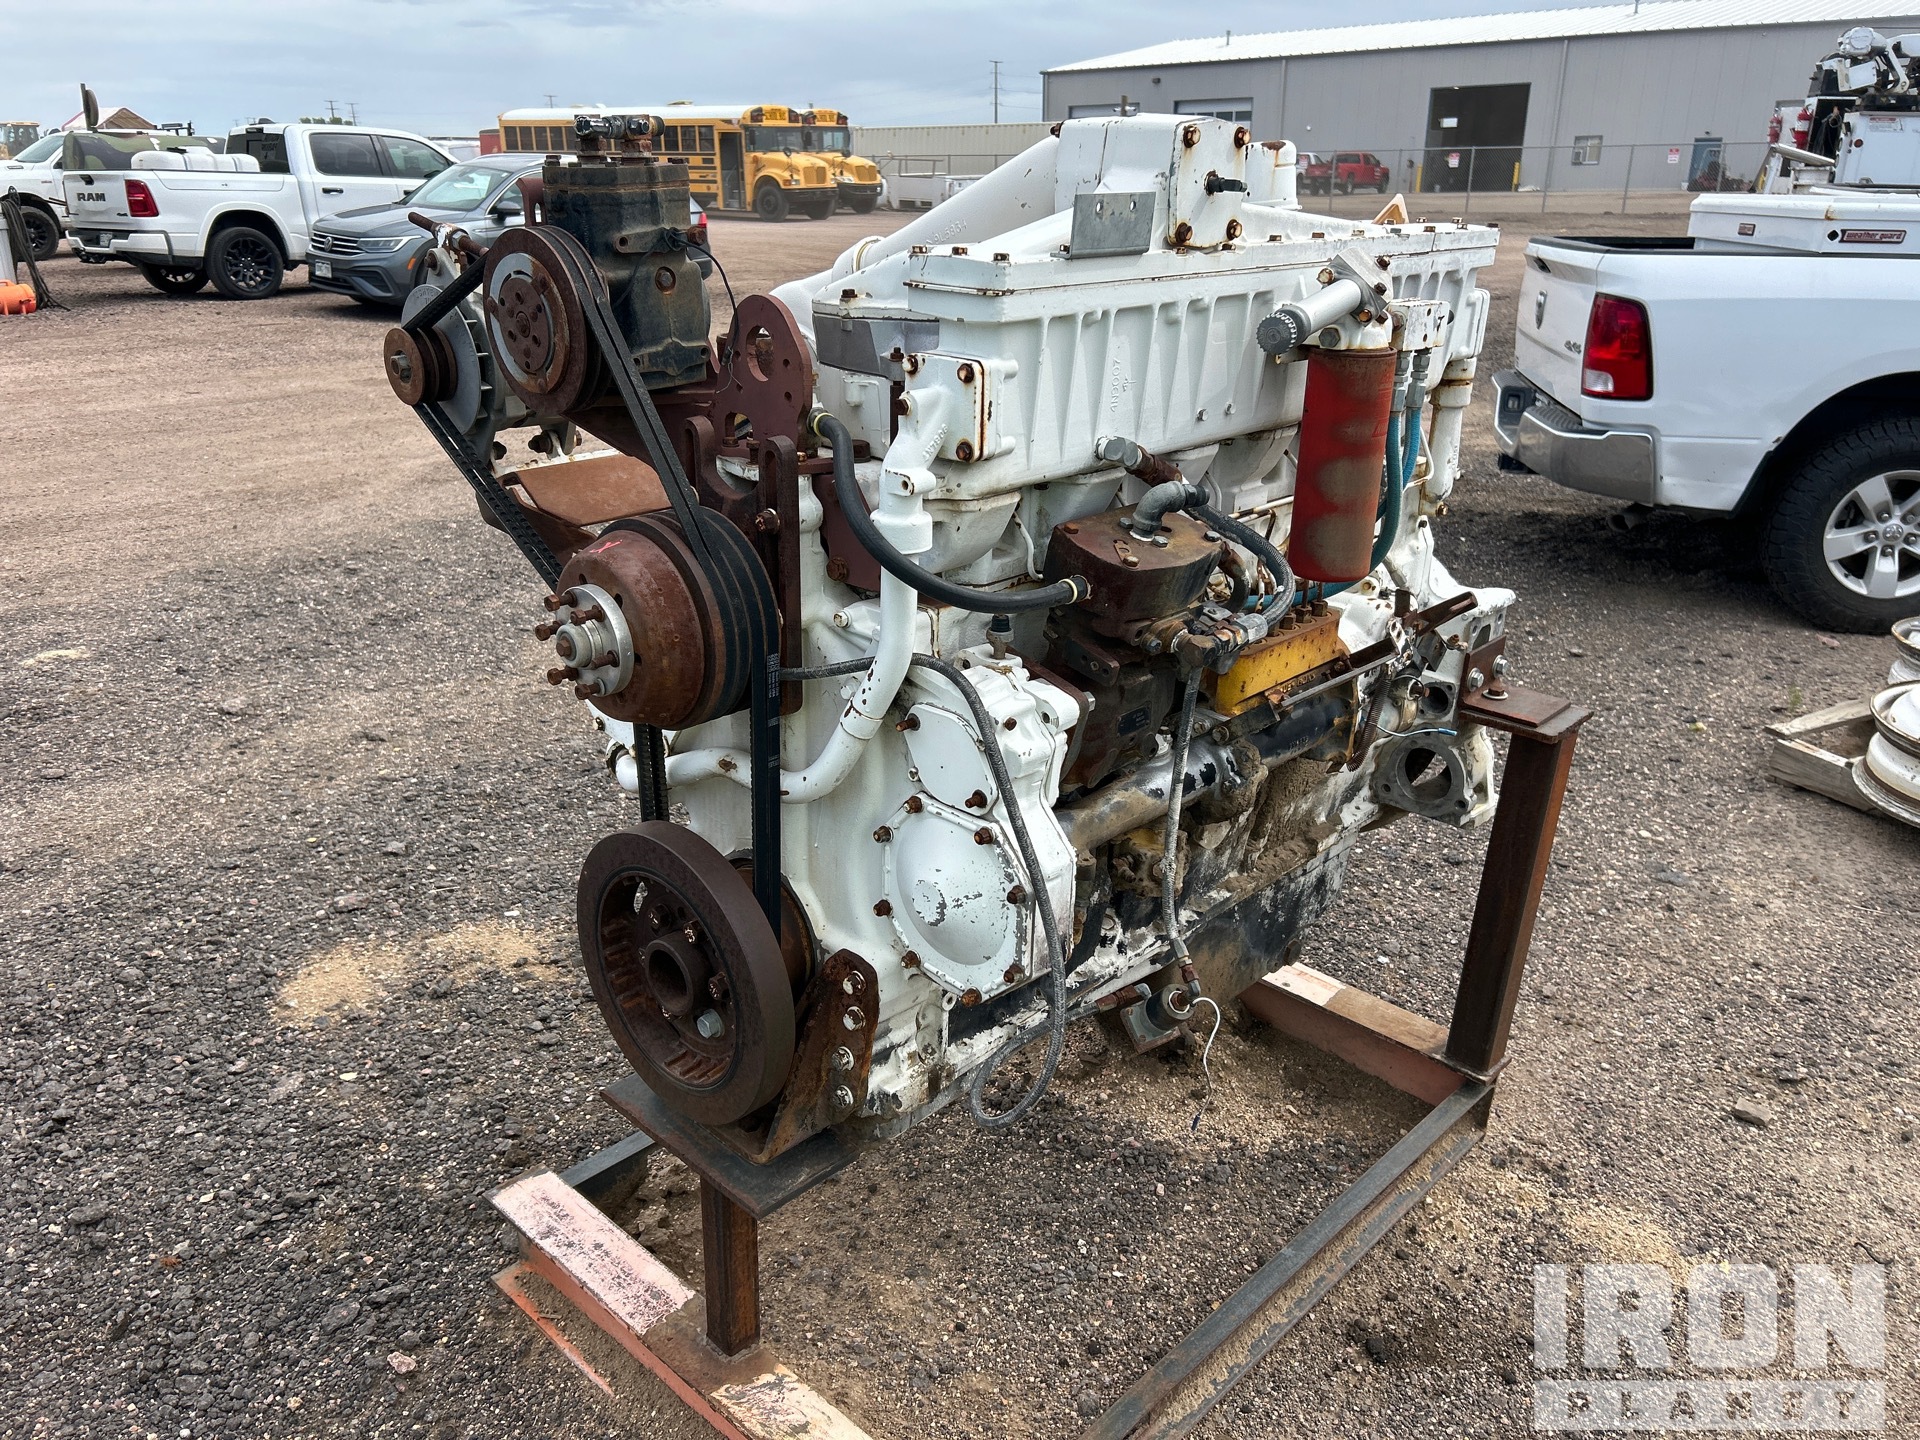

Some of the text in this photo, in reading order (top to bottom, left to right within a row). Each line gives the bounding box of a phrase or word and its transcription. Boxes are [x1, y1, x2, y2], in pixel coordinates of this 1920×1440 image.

[76, 192, 106, 202] RAM
[1846, 231, 1903, 241] weather guard
